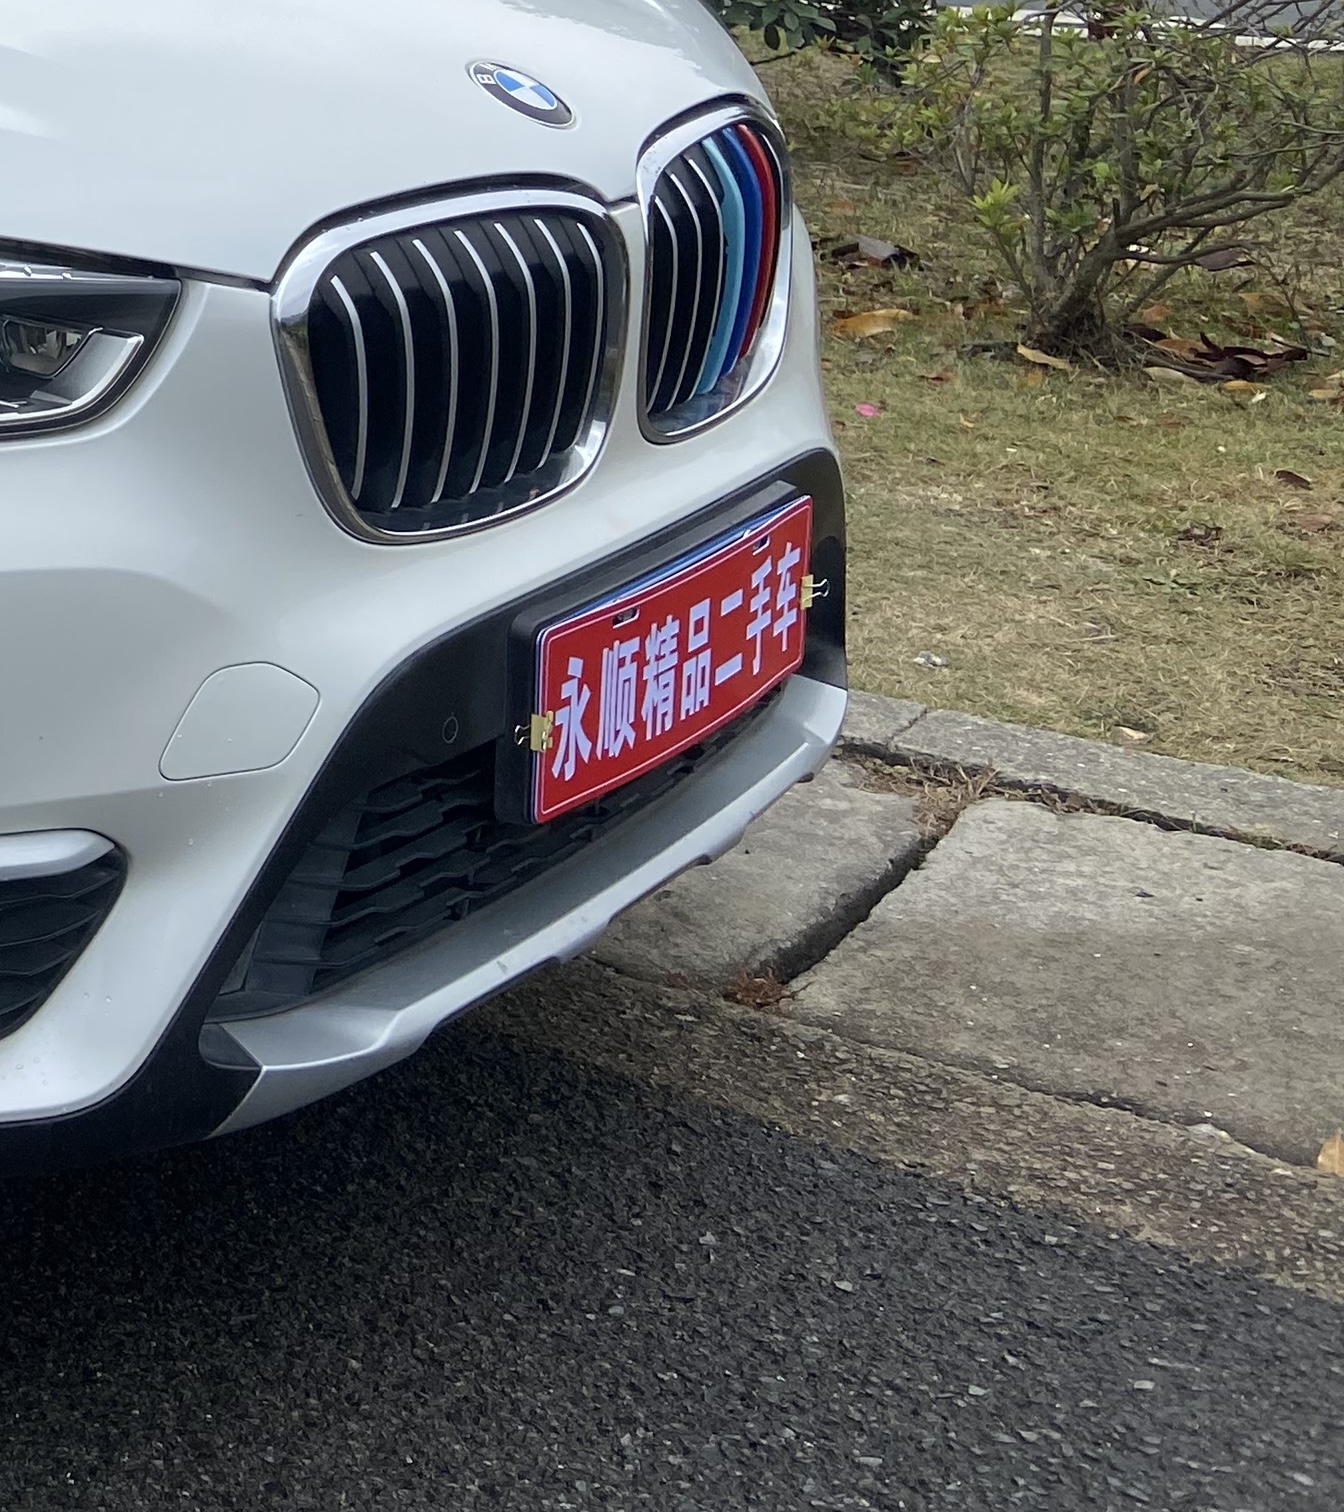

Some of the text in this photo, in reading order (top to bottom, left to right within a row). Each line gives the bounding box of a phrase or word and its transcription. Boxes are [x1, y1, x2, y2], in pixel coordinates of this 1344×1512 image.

[551, 542, 801, 782] 永顺精品二手车
